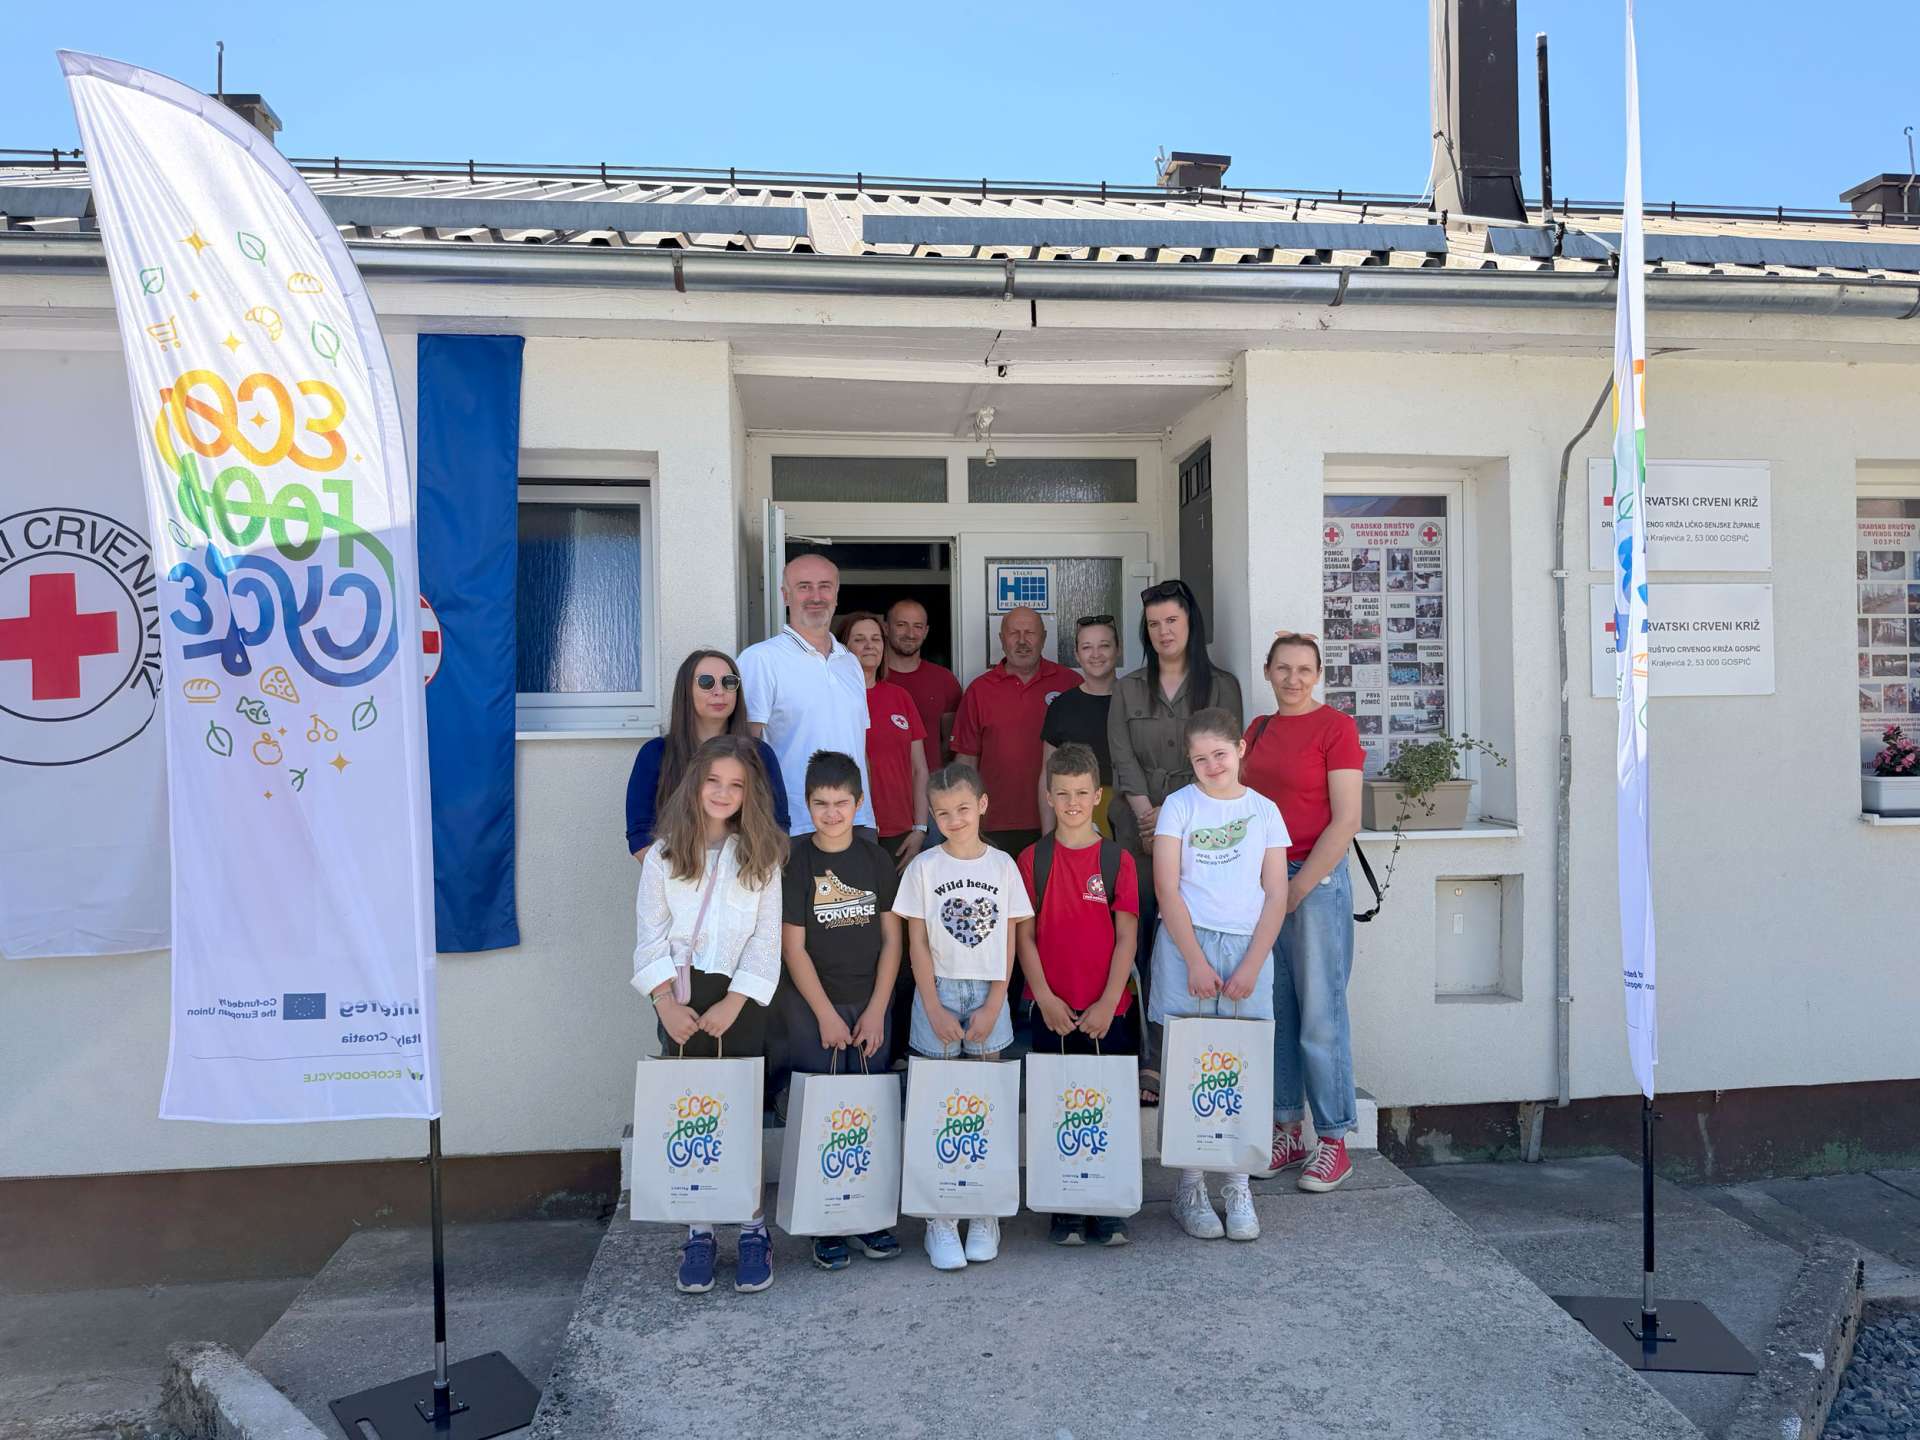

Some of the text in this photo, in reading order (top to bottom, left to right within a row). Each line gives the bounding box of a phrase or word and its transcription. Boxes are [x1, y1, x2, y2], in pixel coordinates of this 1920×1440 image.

[1645, 496, 1759, 507] RVATSKI CRVENI KRIŽ
[1647, 619, 1760, 631] RVATSKI CRVENI KRIŽ
[1648, 645, 1676, 653] RUŠTVO
[934, 879, 999, 896] Wild heart
[816, 904, 876, 924] CONVERSE
[1200, 1052, 1243, 1074] ECO
[1200, 1071, 1239, 1093] FOOD
[677, 1095, 722, 1119] ECO
[946, 1095, 988, 1117] ECO
[1063, 1087, 1105, 1110] ECO
[1192, 1087, 1243, 1117] CYCLE
[677, 1116, 719, 1140] FOOD
[831, 1108, 872, 1130] ECO
[945, 1114, 986, 1137] FOOD
[1065, 1107, 1103, 1130] FOOD
[667, 1134, 722, 1167] CYCLE
[830, 1127, 868, 1152] FOOD
[936, 1133, 988, 1164] CYCLE
[1056, 1125, 1108, 1156] CYCLE
[821, 1145, 871, 1179] CYCLE
